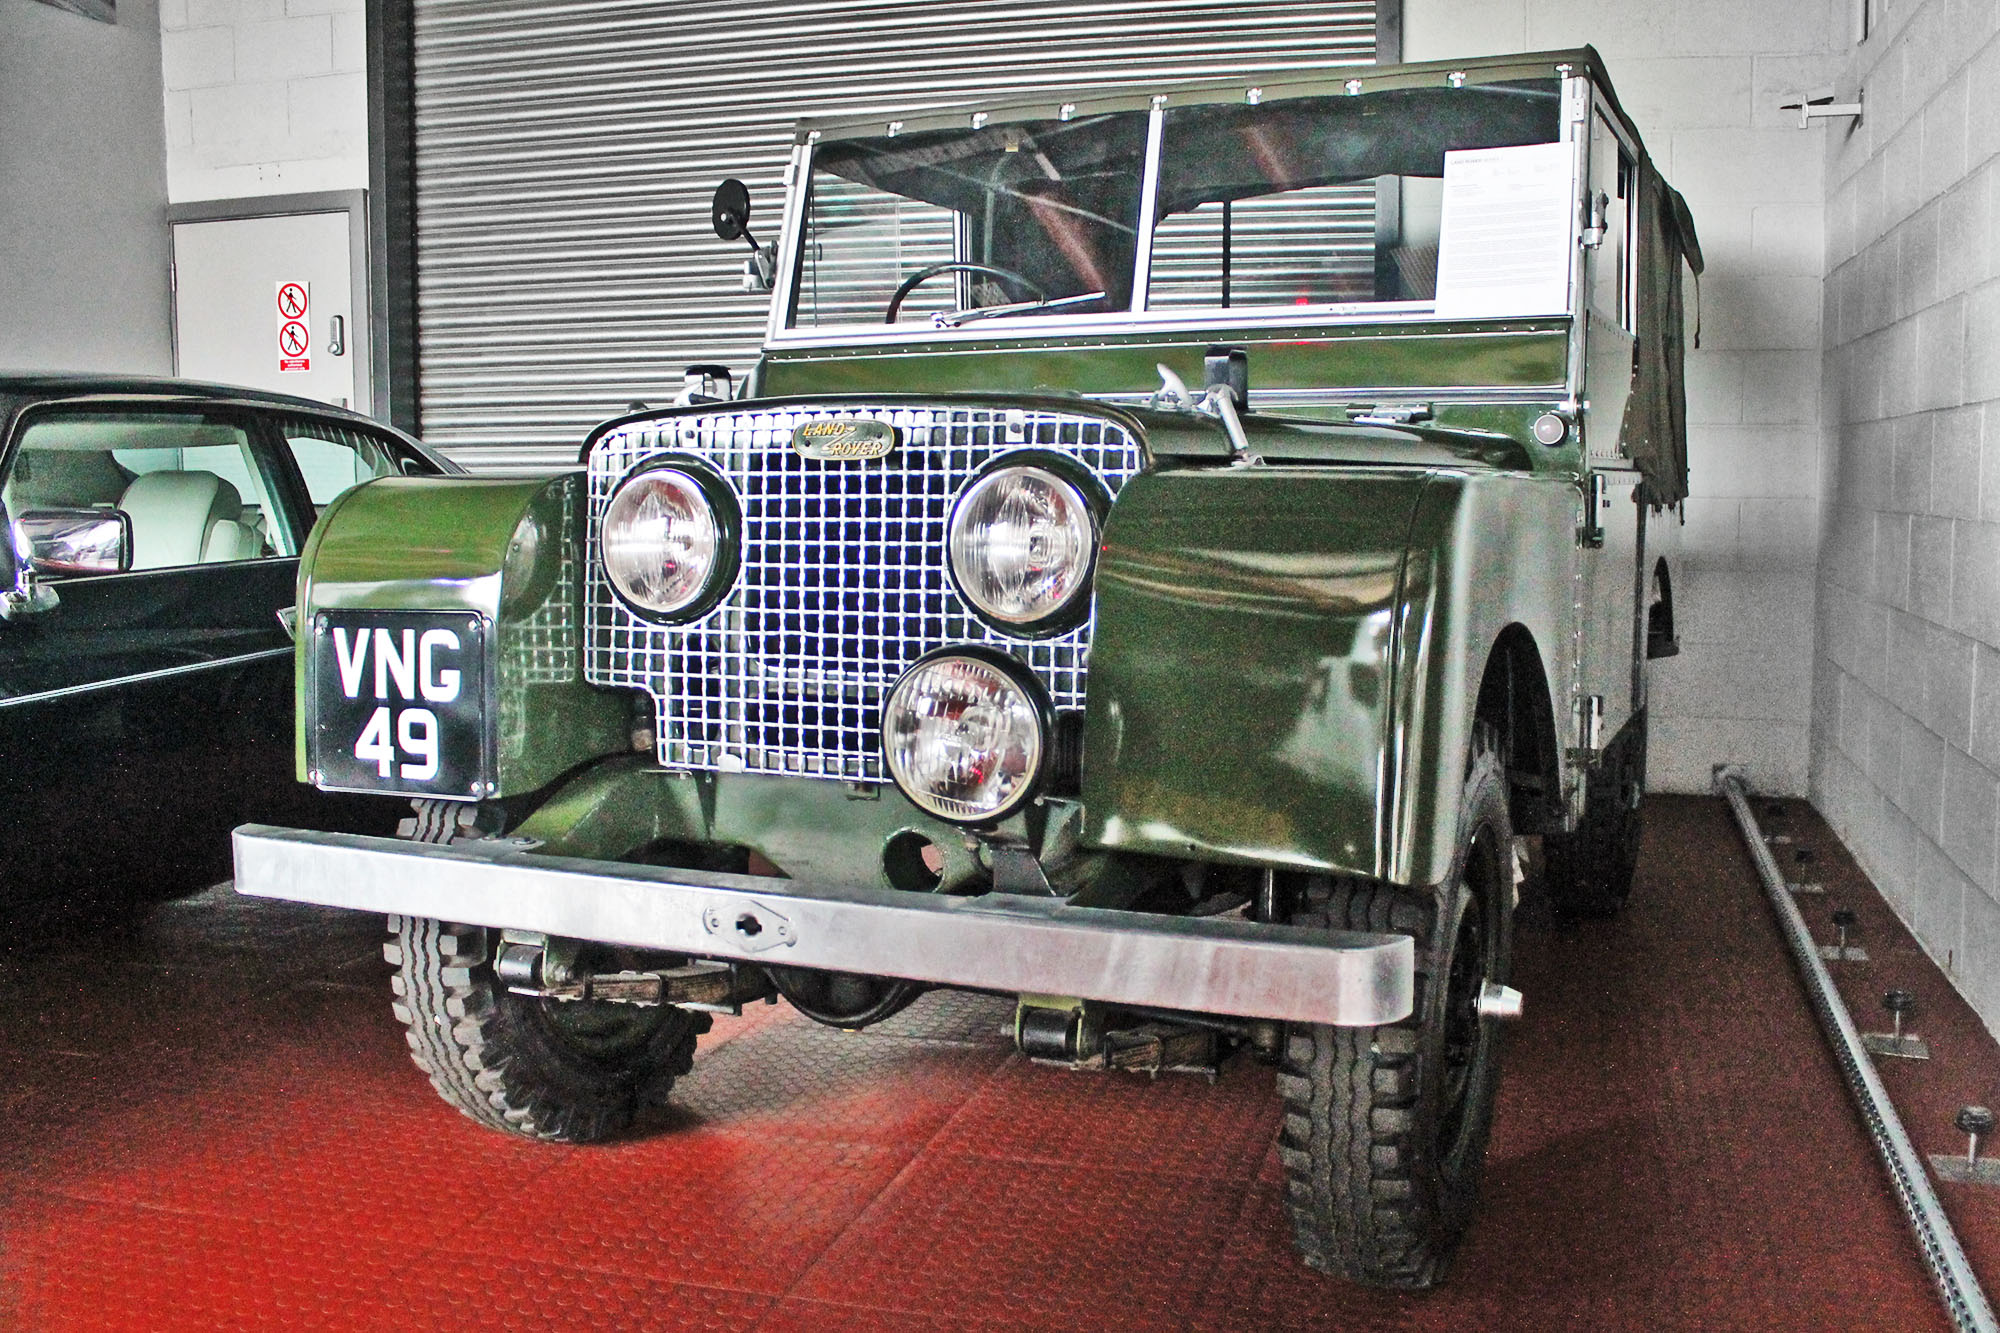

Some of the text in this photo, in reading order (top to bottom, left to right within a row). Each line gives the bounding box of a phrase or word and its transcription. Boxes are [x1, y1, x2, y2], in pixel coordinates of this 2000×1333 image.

[803, 423, 846, 436] LAND
[830, 440, 883, 456] ROVER
[332, 627, 462, 703] VNG
[353, 706, 440, 781] 49
